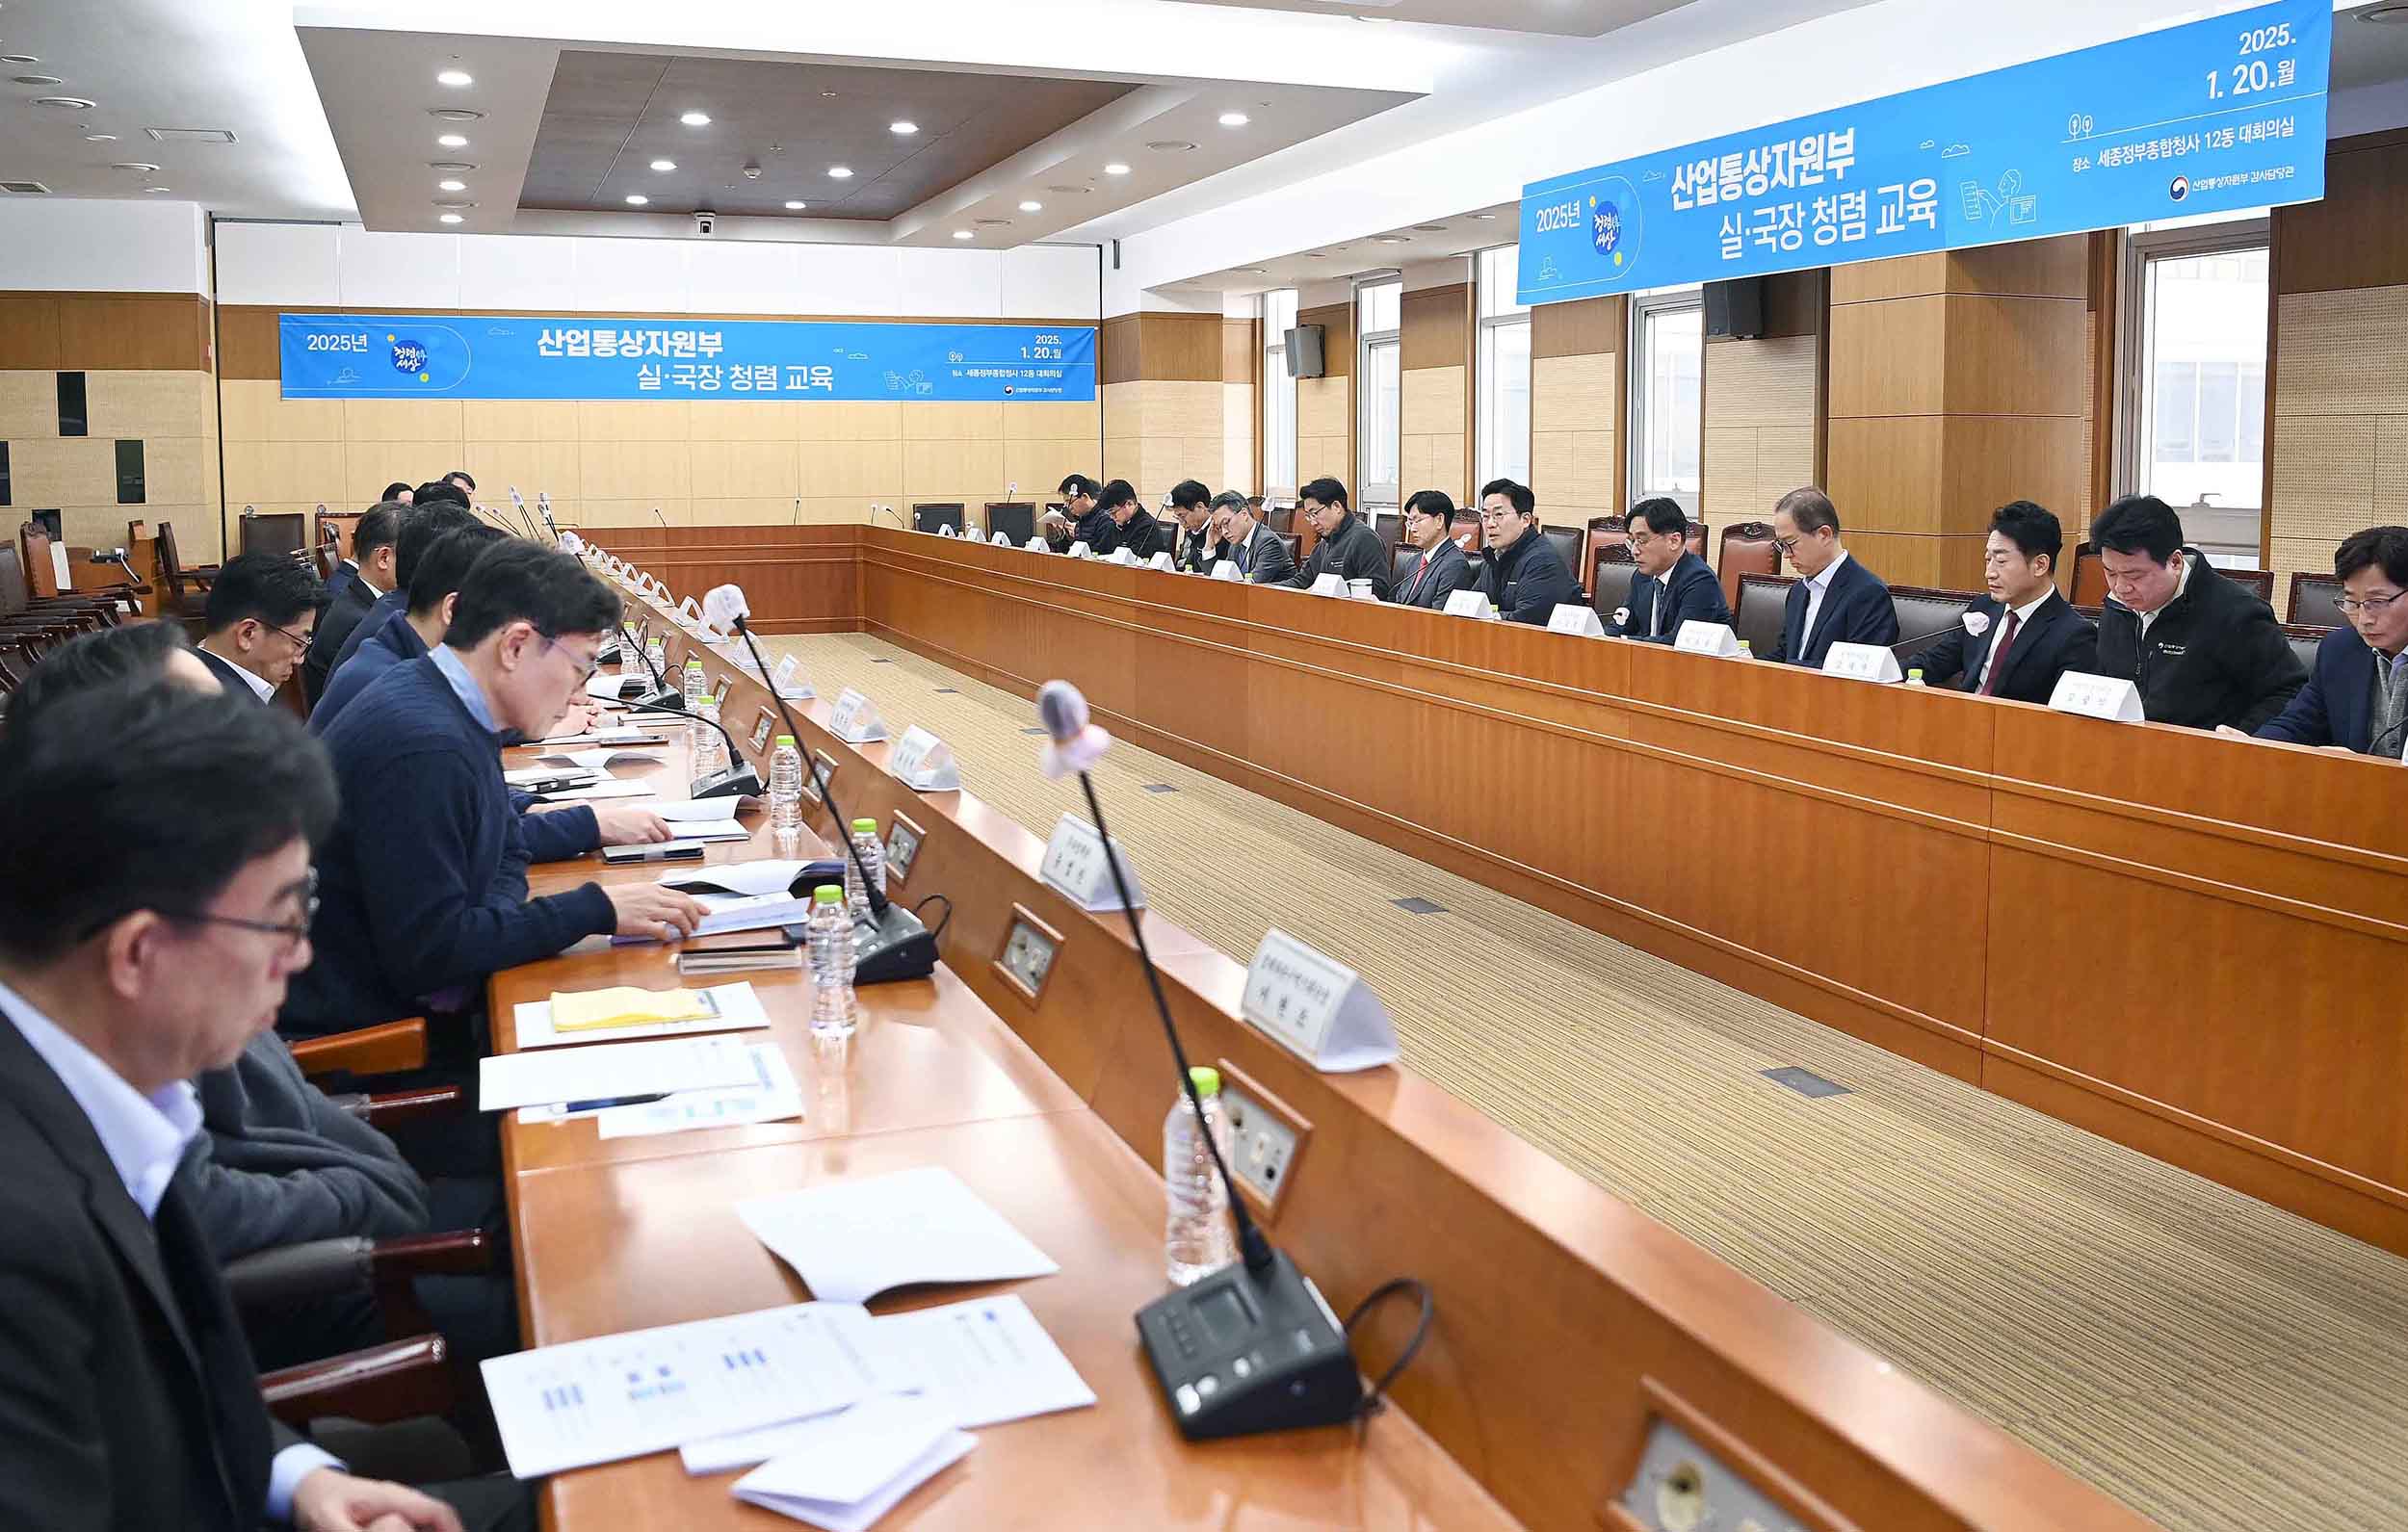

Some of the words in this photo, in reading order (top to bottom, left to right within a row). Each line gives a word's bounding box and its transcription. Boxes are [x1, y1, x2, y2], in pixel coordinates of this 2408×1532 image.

[2238, 22, 2296, 56] 2025.
[2206, 69, 2224, 100] 1.
[2072, 156, 2091, 174] 장소
[2097, 132, 2201, 169] 세종정부종합청사
[2204, 126, 2236, 150] 12동
[2238, 115, 2295, 144] 대회의실
[1670, 127, 1856, 212] 산업통상자원부
[1535, 199, 1582, 234] 2025년
[1718, 200, 1807, 261] 실·국장
[1811, 189, 1867, 247] 청렴
[1874, 176, 1939, 237] 교육
[306, 332, 369, 353] 2025년
[537, 328, 723, 359] 산업통상자원부
[1020, 346, 1031, 359] 1.
[1035, 334, 1062, 345] 2025.
[637, 363, 723, 391] 실·국장
[728, 364, 778, 392] 청렴
[784, 365, 834, 392] 교육
